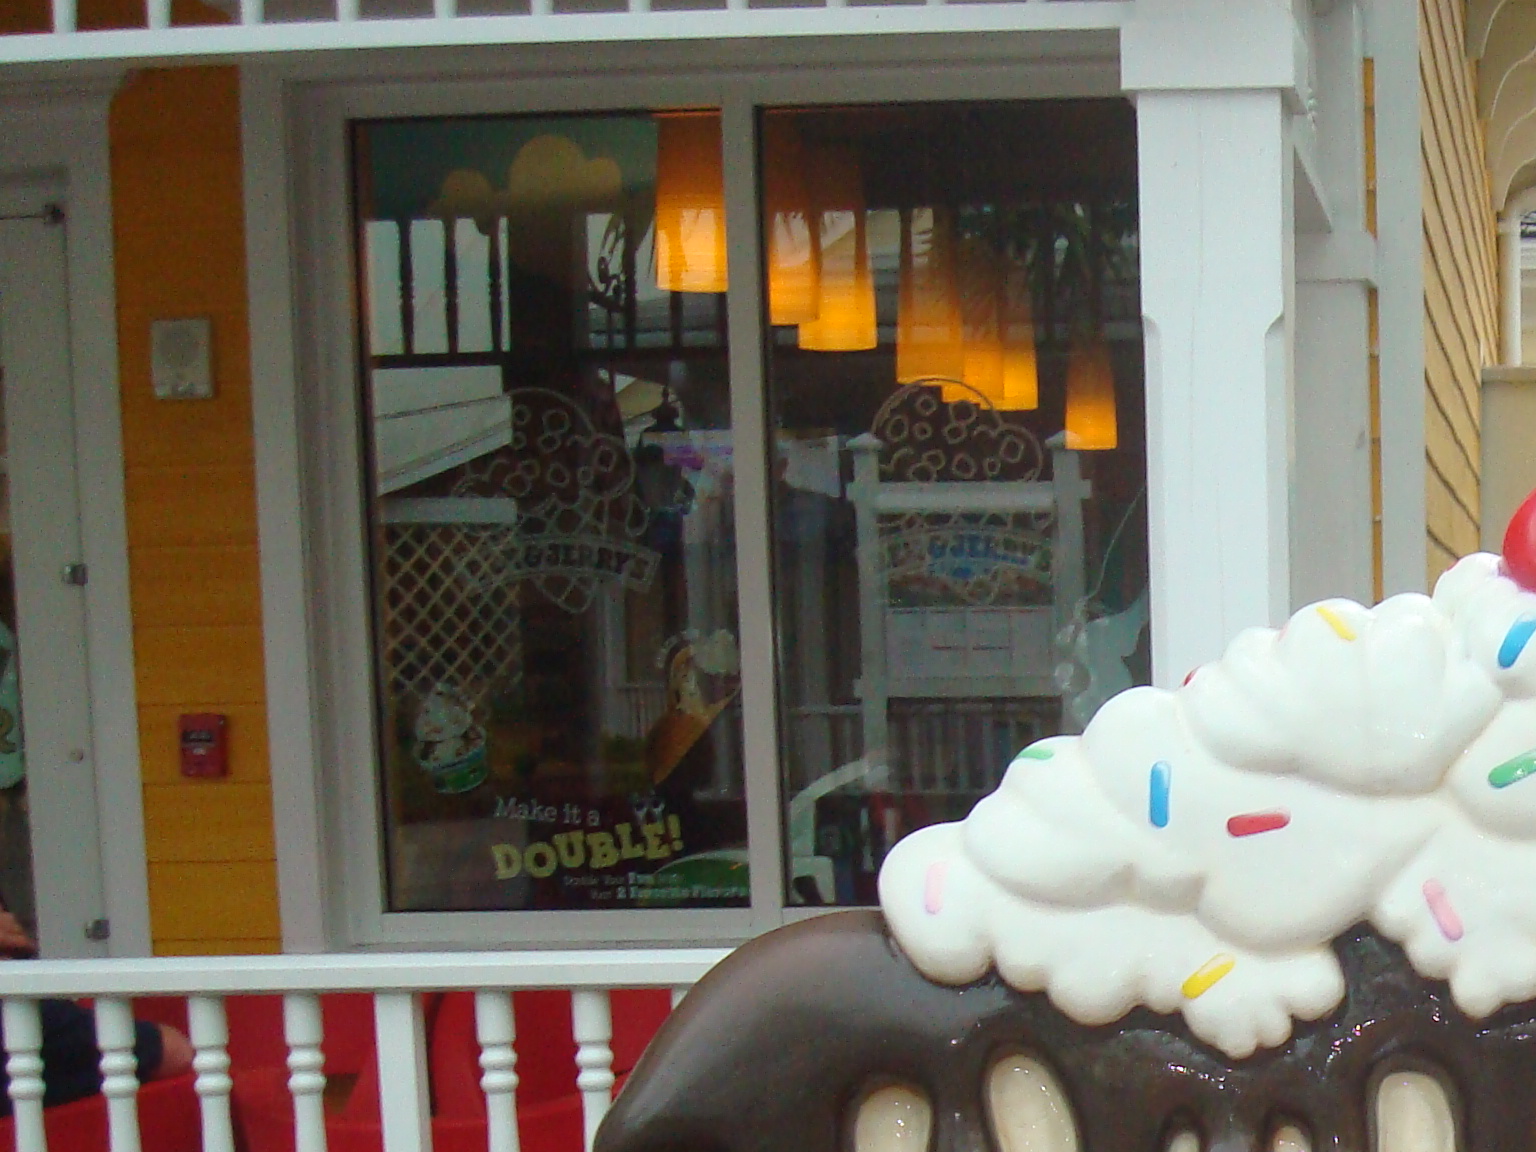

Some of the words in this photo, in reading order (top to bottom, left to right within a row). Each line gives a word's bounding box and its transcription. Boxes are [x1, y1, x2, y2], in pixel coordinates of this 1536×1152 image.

[546, 543, 652, 584] JERRY'S
[493, 796, 558, 823] Make
[563, 802, 582, 825] it
[586, 808, 600, 827] a
[491, 812, 685, 880] DOUBLE!
[616, 885, 627, 900] 2
